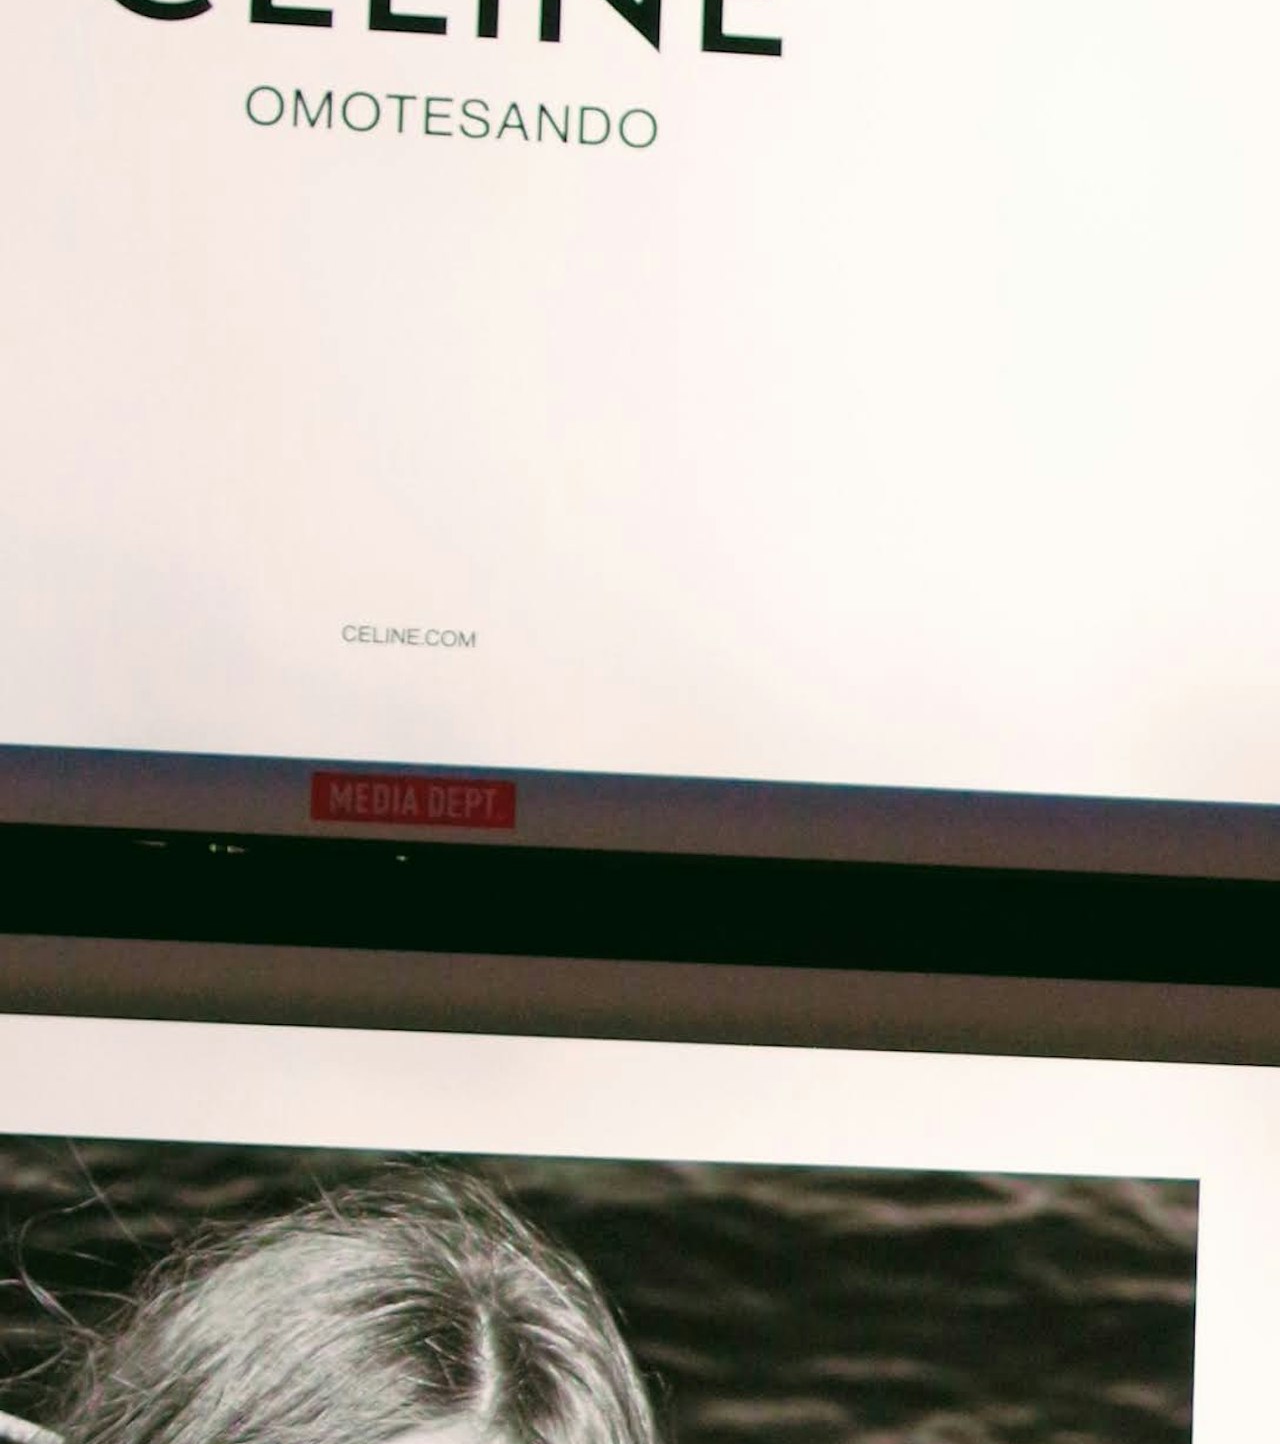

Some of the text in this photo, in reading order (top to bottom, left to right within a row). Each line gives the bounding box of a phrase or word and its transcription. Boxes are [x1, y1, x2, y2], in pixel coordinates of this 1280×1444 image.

[244, 84, 659, 149] OMOTESANDO
[341, 623, 477, 648] CELINE.COM
[329, 782, 418, 816] MEDIA
